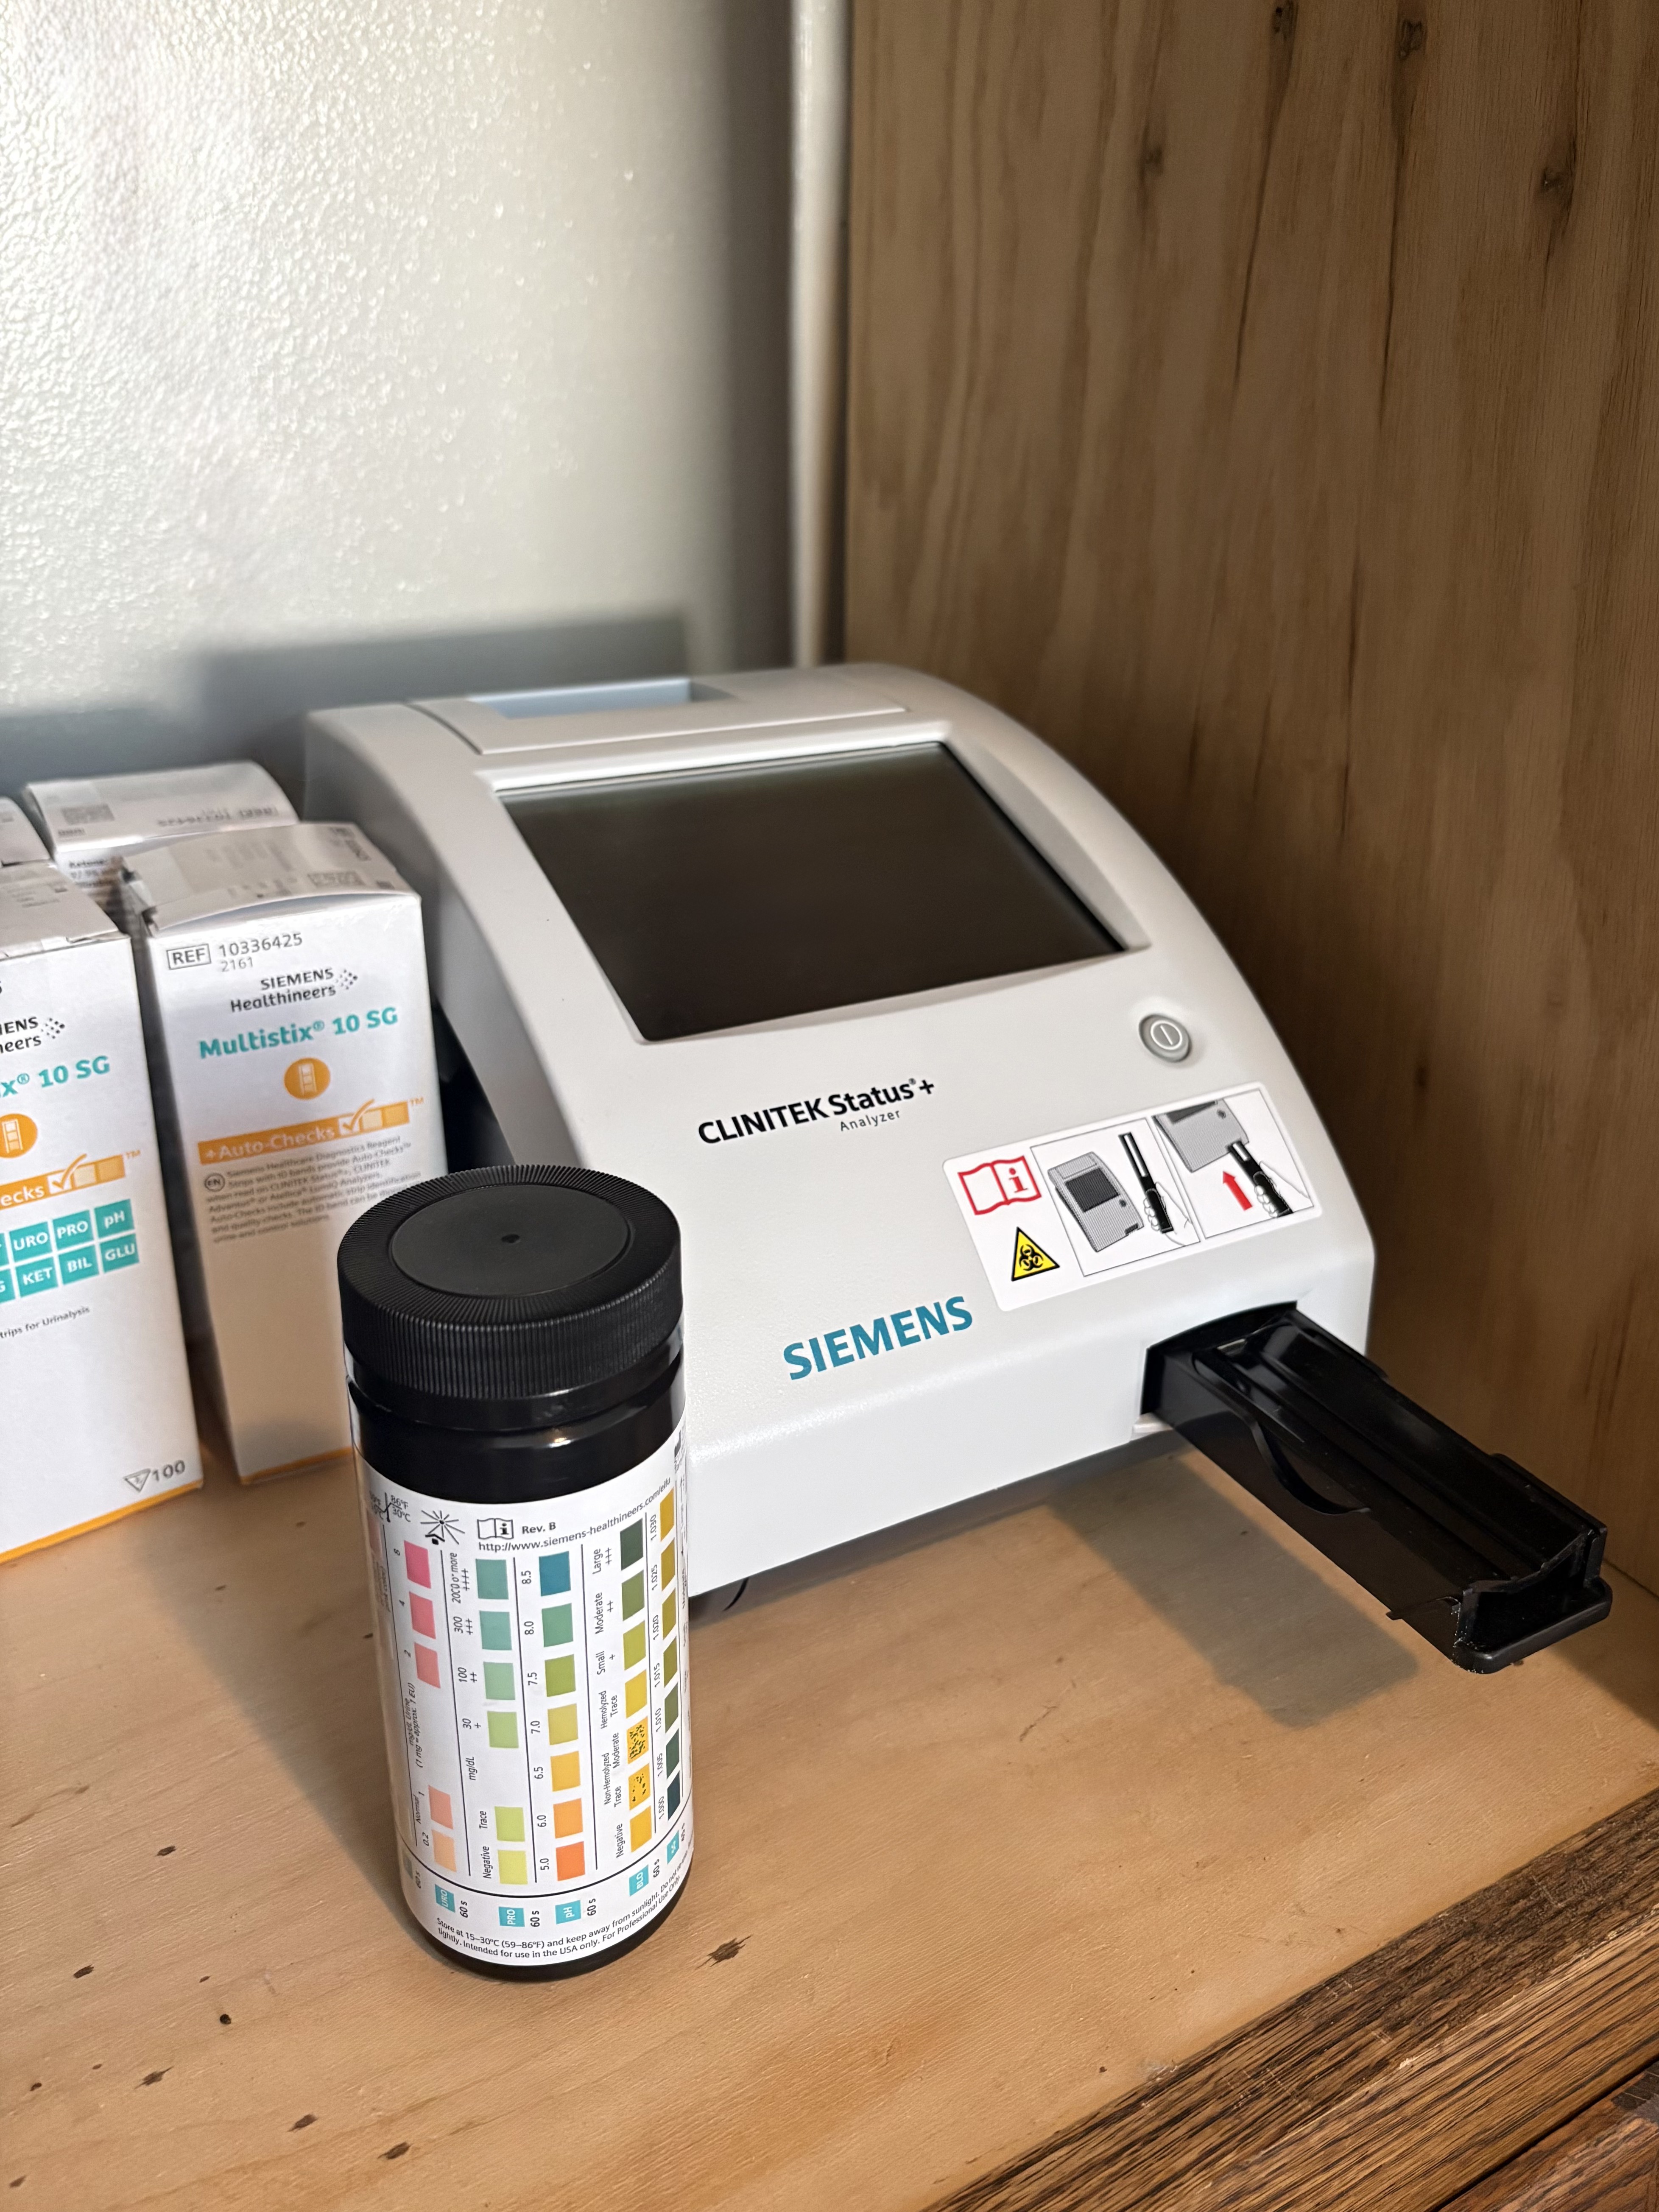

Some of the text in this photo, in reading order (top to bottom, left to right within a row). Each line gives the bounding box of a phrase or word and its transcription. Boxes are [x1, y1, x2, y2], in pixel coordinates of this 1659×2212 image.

[171, 933, 303, 966] REF 10336425
[221, 957, 254, 972] 2161
[260, 968, 334, 991] SIEMENS
[230, 984, 336, 1013] Healthineers
[200, 1007, 398, 1059] Multistix® 10 SG
[0, 1055, 111, 1098] x® 10 SG
[698, 1098, 830, 1144] CLINITEK
[839, 1109, 901, 1132] Analyzer
[14, 1210, 126, 1251] URO PRO pH
[23, 1243, 136, 1286] KET BIL GLU
[25, 1321, 40, 1332] for
[42, 1305, 90, 1326] Urinalysis
[783, 1296, 973, 1381] SIEMENS
[151, 1459, 186, 1483] 100
[478, 1477, 671, 1552] http://www.siemens-healthineers.com/eifu
[522, 1522, 556, 1534] Rev. B
[450, 1552, 458, 1573] more
[592, 1548, 603, 1575] Large
[521, 1570, 532, 1585] 8.5
[595, 1592, 604, 1635] Moderate
[606, 1600, 614, 1612] ++
[453, 1616, 464, 1634] 300
[465, 1618, 473, 1635] +++
[523, 1620, 534, 1635] 8.0
[404, 1649, 411, 1658] 2
[596, 1650, 605, 1676] Small
[458, 1667, 467, 1683] 100
[469, 1671, 478, 1683] ++
[527, 1672, 538, 1686] 7.5
[407, 1682, 416, 1698] EU)
[598, 1690, 608, 1729] Hemolyzed
[610, 1695, 618, 1718] Trace
[462, 1718, 472, 1729] 30
[531, 1720, 541, 1734] 7.0
[415, 1745, 423, 1758] mg
[612, 1732, 620, 1768] Moderate
[466, 1756, 478, 1781] mg/dL
[533, 1766, 544, 1779] 6.5
[601, 1752, 612, 1805] Non-Hemolyzed
[479, 1810, 488, 1829] Trace
[537, 1814, 547, 1828] 6.0
[616, 1823, 626, 1858] Negative
[483, 1846, 494, 1879] Negative
[539, 1858, 550, 1871] 5.0
[636, 1872, 644, 1890] BLO
[653, 1865, 660, 1878] 60
[437, 1917, 455, 1930] Store
[547, 1938, 564, 1947] and
[566, 1933, 587, 1945] keep
[589, 1924, 610, 1938] away
[612, 1914, 631, 1928] from
[631, 1892, 660, 1917] sunlight.
[660, 1881, 668, 1893] Do
[668, 1868, 677, 1883] not
[459, 1906, 468, 1918] 60
[506, 1909, 516, 1925] PRO
[530, 1916, 540, 1927] 60
[563, 1906, 575, 1918] pH
[587, 1905, 596, 1916] 60
[438, 1927, 462, 1946] tightly.
[463, 1940, 498, 1956] Intended
[500, 1949, 513, 1958] for
[532, 1950, 541, 1958] in
[542, 1949, 558, 1958] the
[559, 1944, 578, 1955] USA
[579, 1938, 600, 1951] only.
[602, 1930, 616, 1942] For
[617, 1900, 658, 1935] Professional
[658, 1890, 669, 1905] Use
